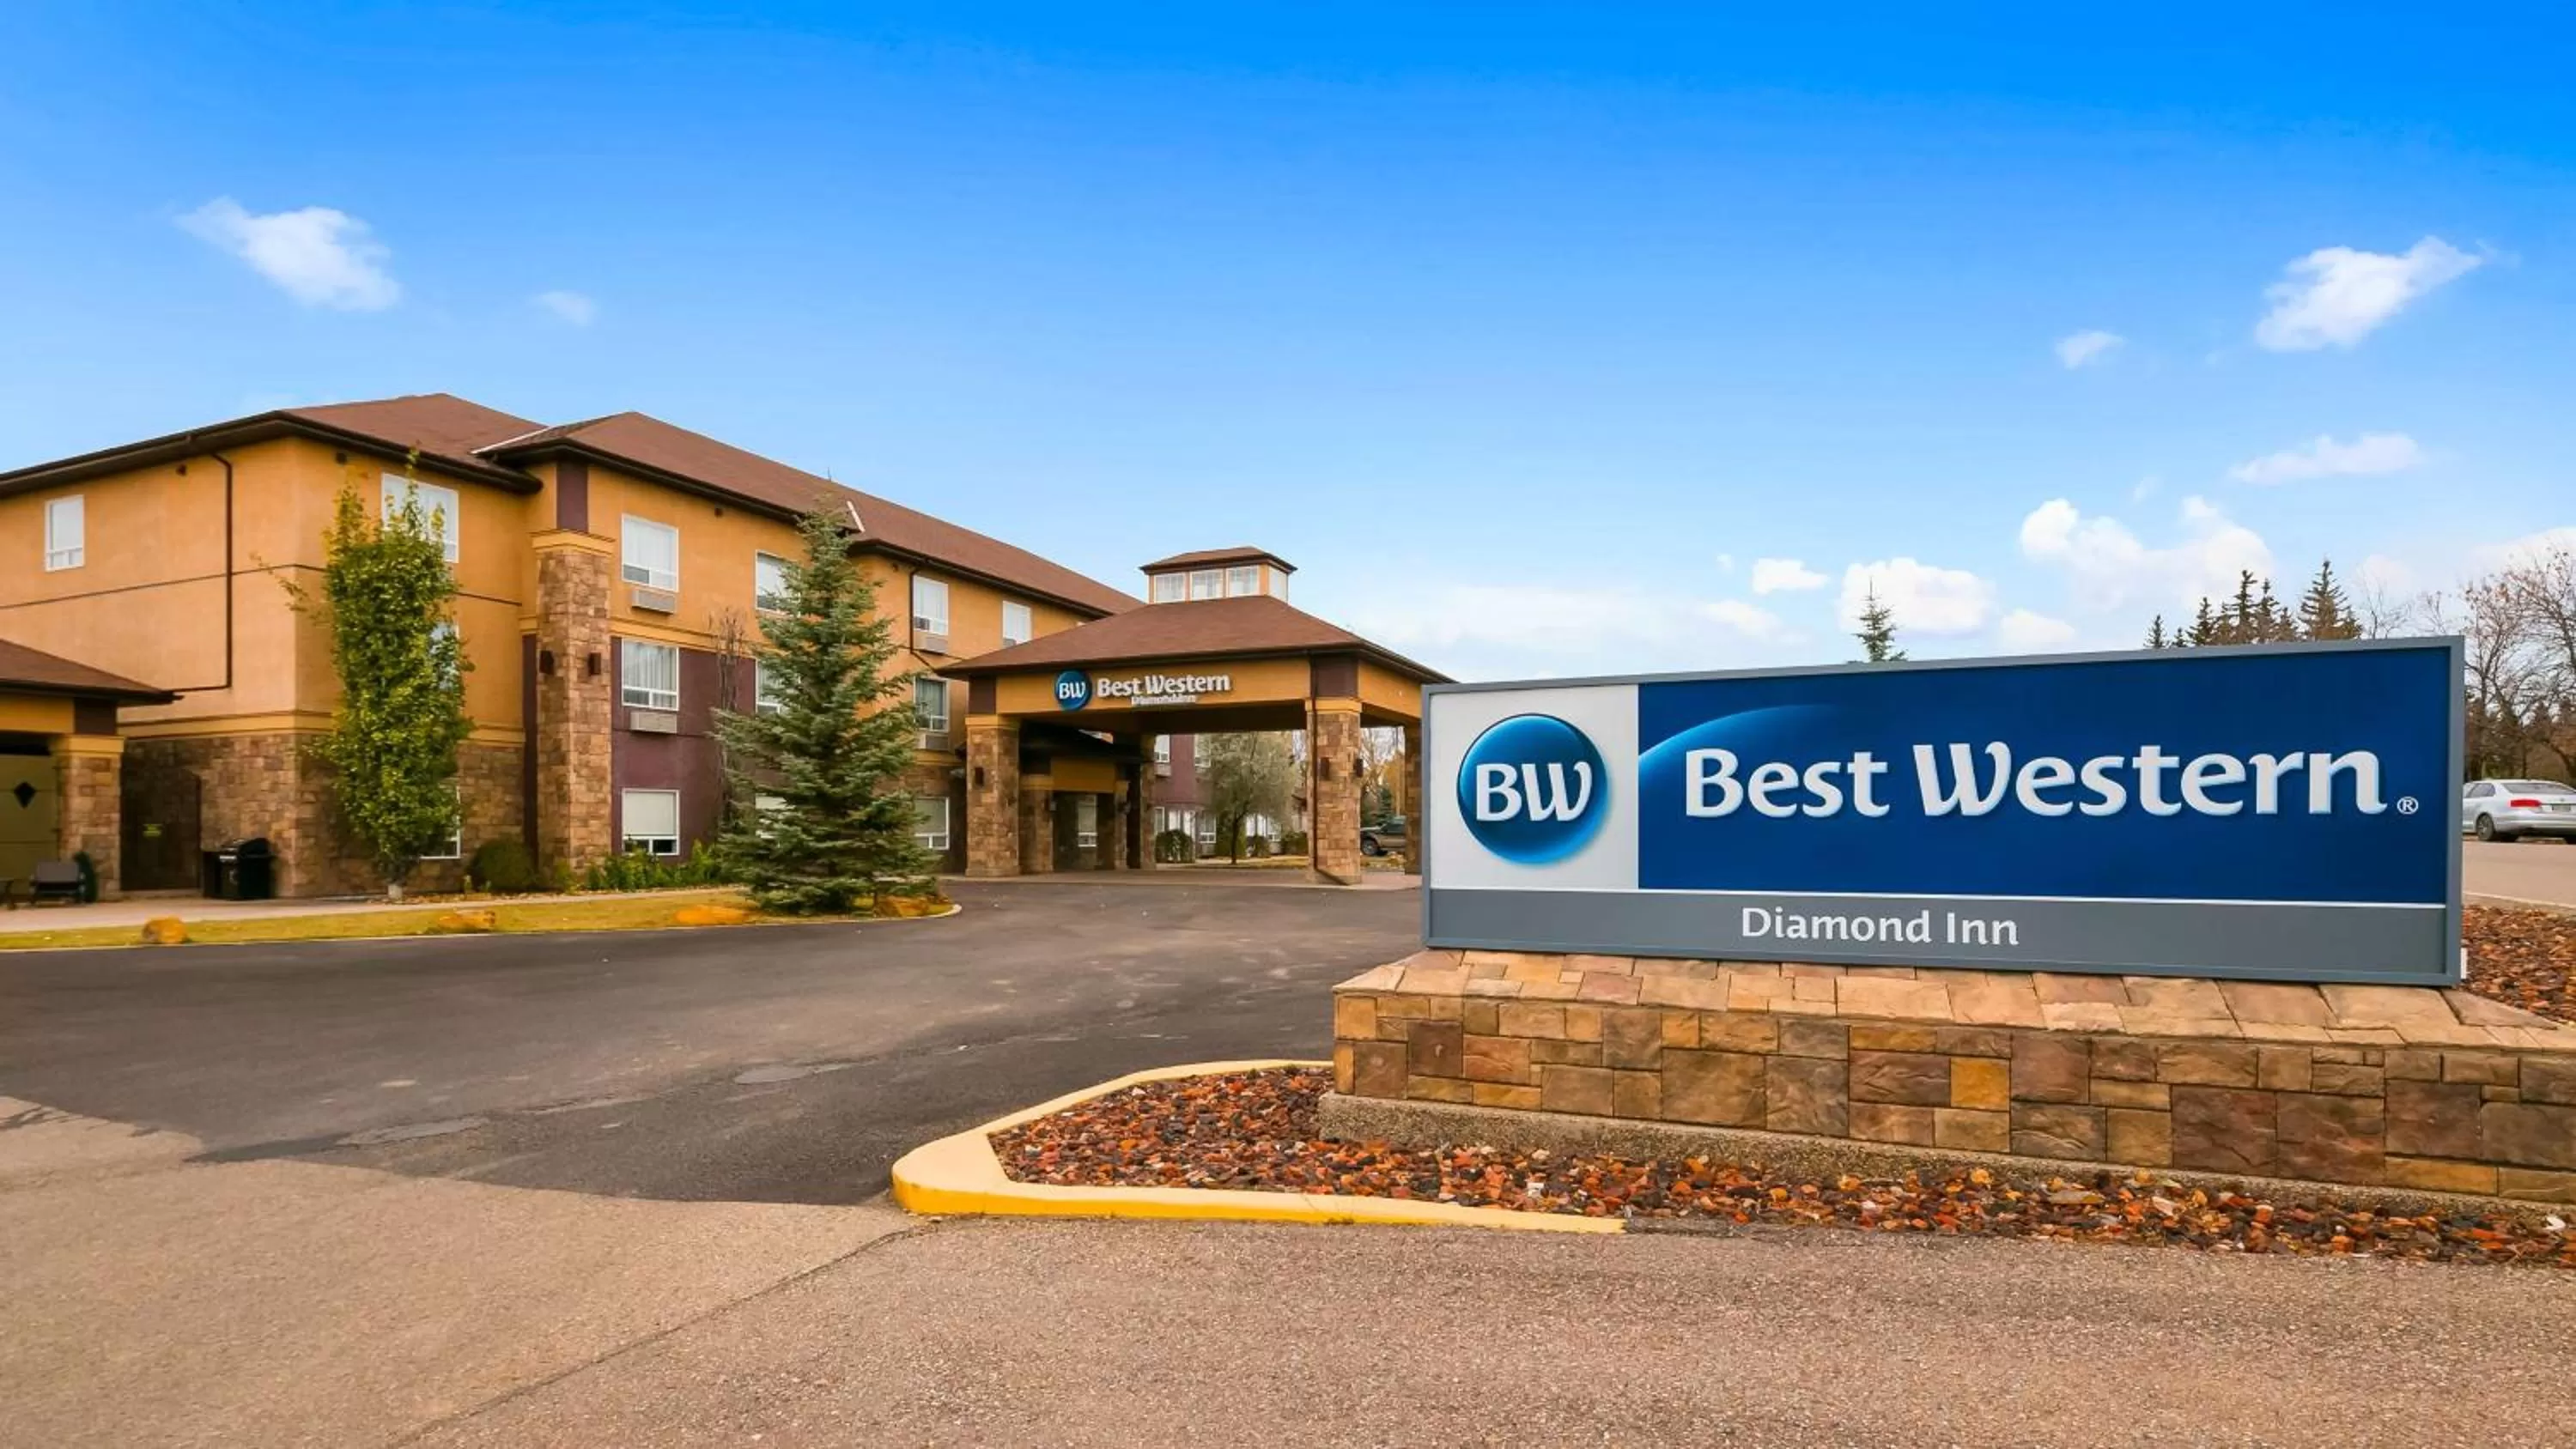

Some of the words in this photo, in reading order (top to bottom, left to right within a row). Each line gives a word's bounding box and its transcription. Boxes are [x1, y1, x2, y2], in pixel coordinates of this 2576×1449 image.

[1059, 682, 1085, 699] BW
[1097, 677, 1141, 697] Best
[1145, 674, 1230, 694] Western
[1475, 761, 1593, 822] BW
[1686, 748, 1890, 817] Best
[1912, 741, 2388, 816] Western
[1741, 906, 1932, 943] Diamond
[1946, 912, 2020, 946] Inn
